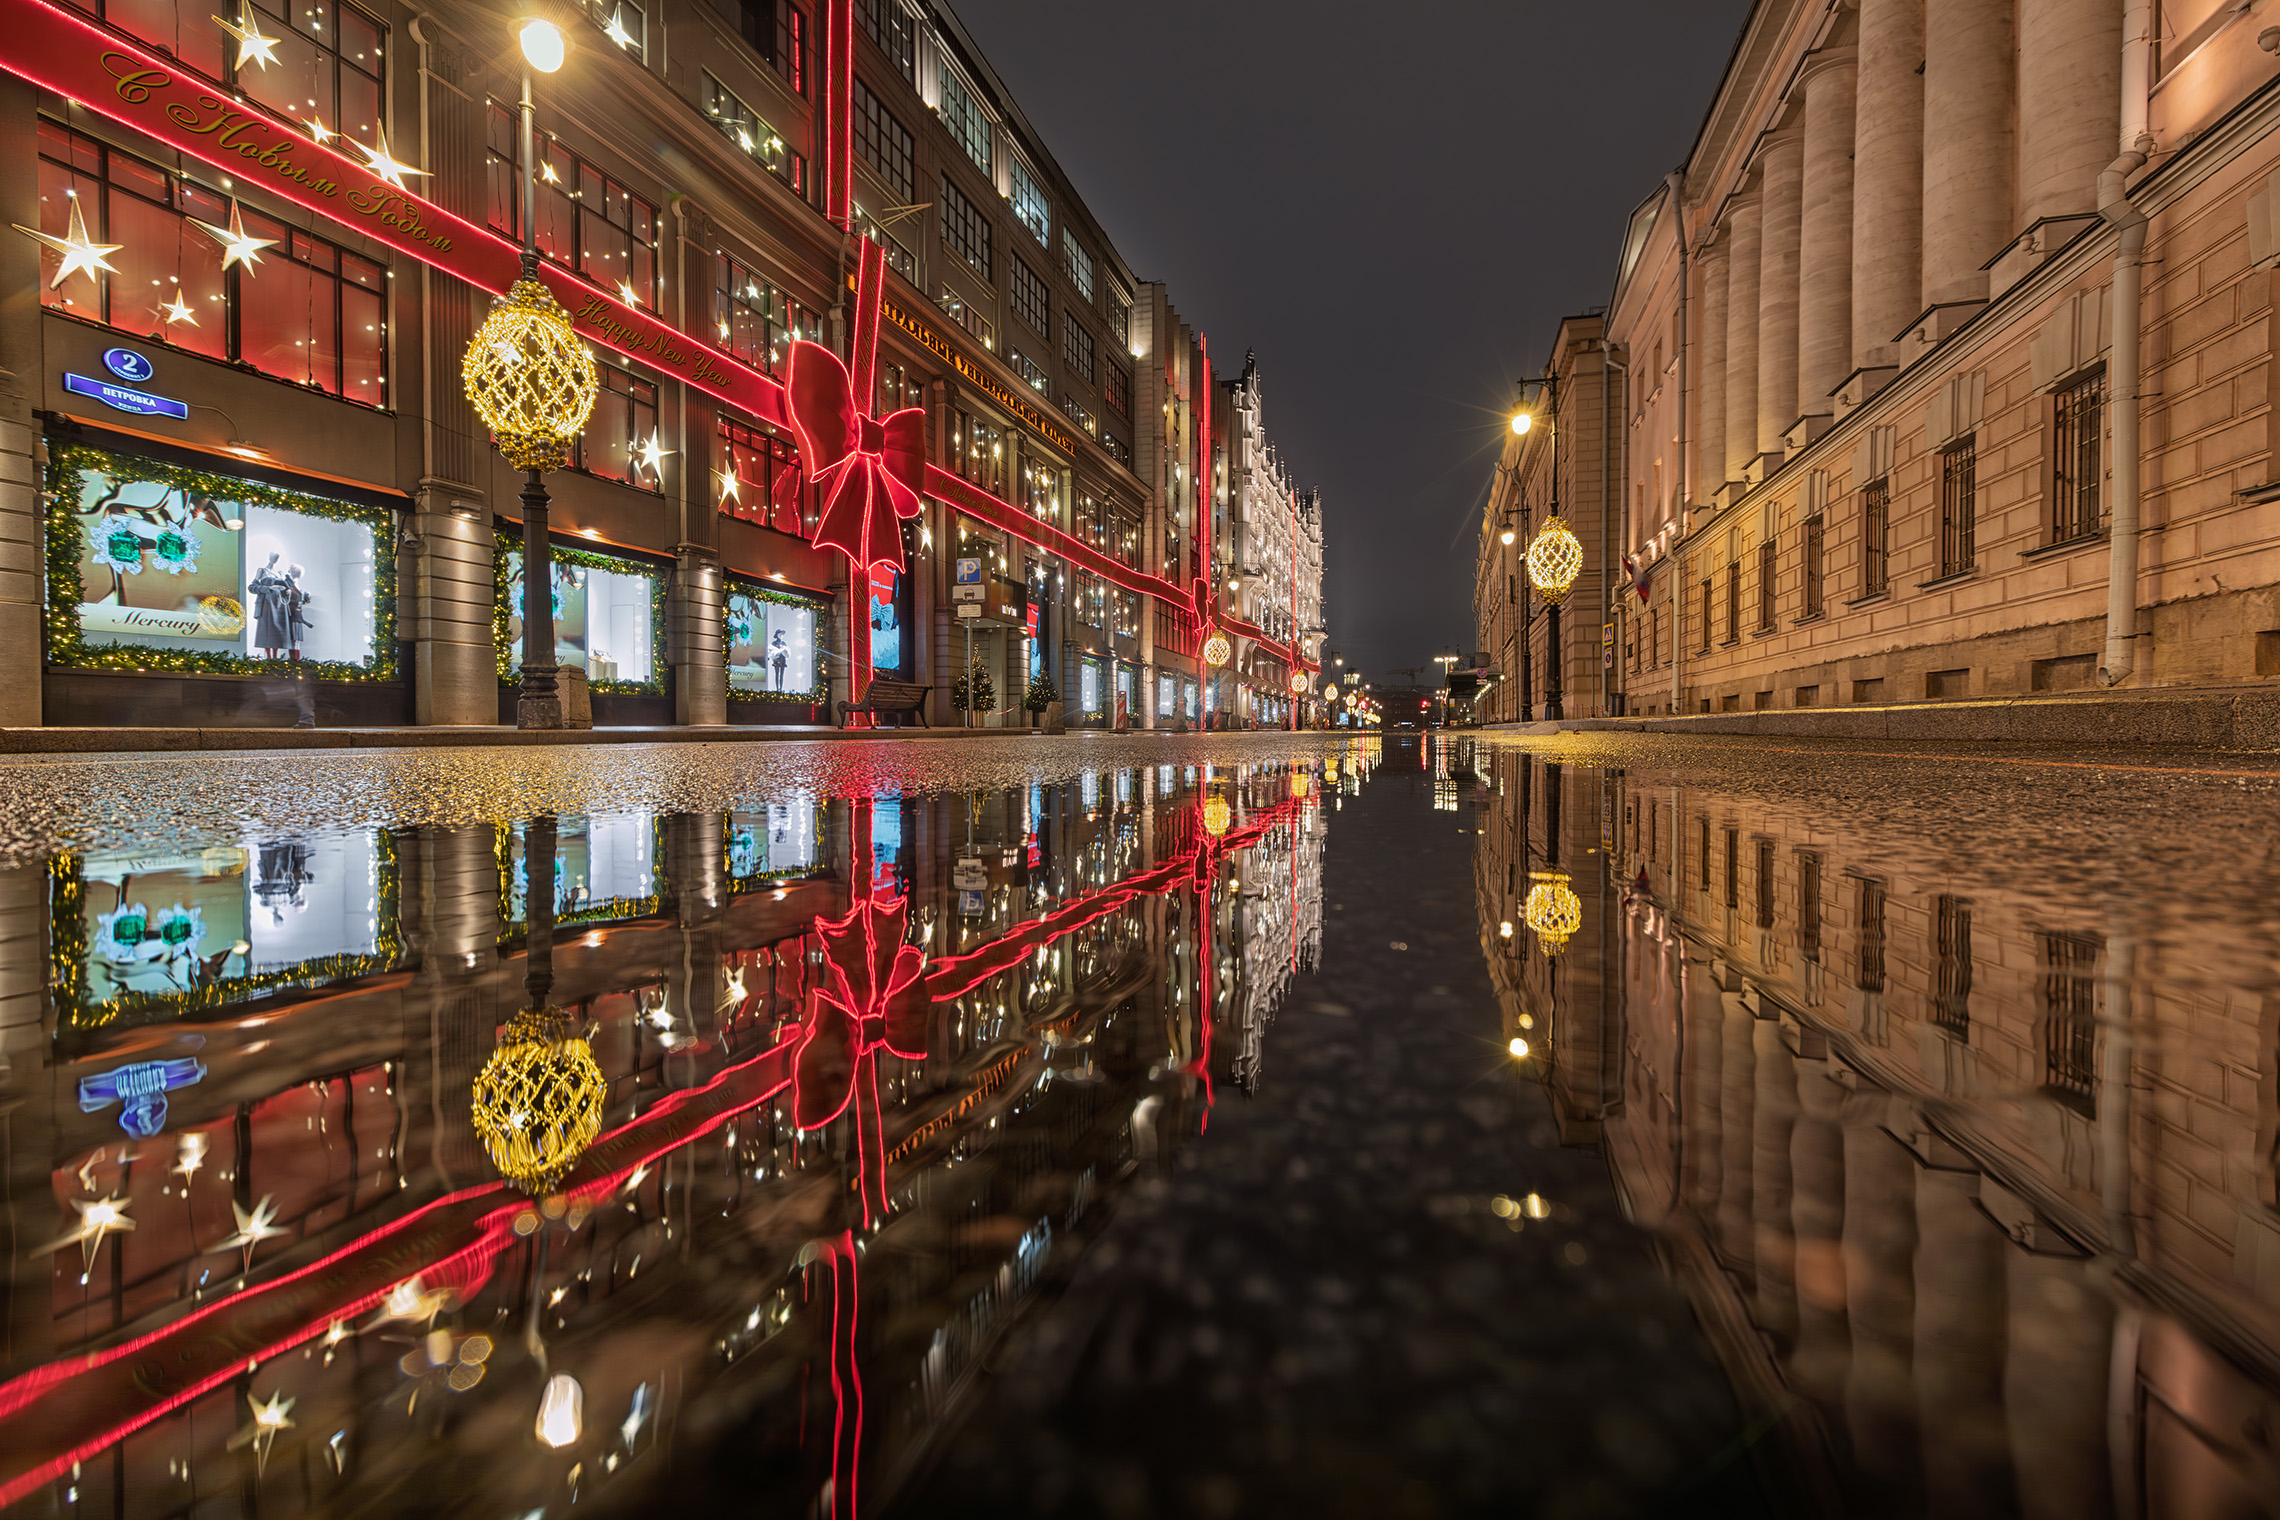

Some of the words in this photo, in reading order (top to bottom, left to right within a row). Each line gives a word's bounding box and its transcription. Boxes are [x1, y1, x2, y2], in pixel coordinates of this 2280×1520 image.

[101, 51, 171, 104] С
[166, 95, 338, 198] Новым
[346, 185, 453, 253] Годом
[576, 293, 645, 351] Happy
[645, 331, 686, 366] New
[690, 350, 732, 388] Year
[122, 353, 138, 373] 2
[102, 386, 157, 408] ПЕТРОВКА
[959, 360, 1041, 430] УНИВЕРСАЛЬНЫЙ
[963, 561, 977, 581] P
[111, 610, 201, 636] Mercury
